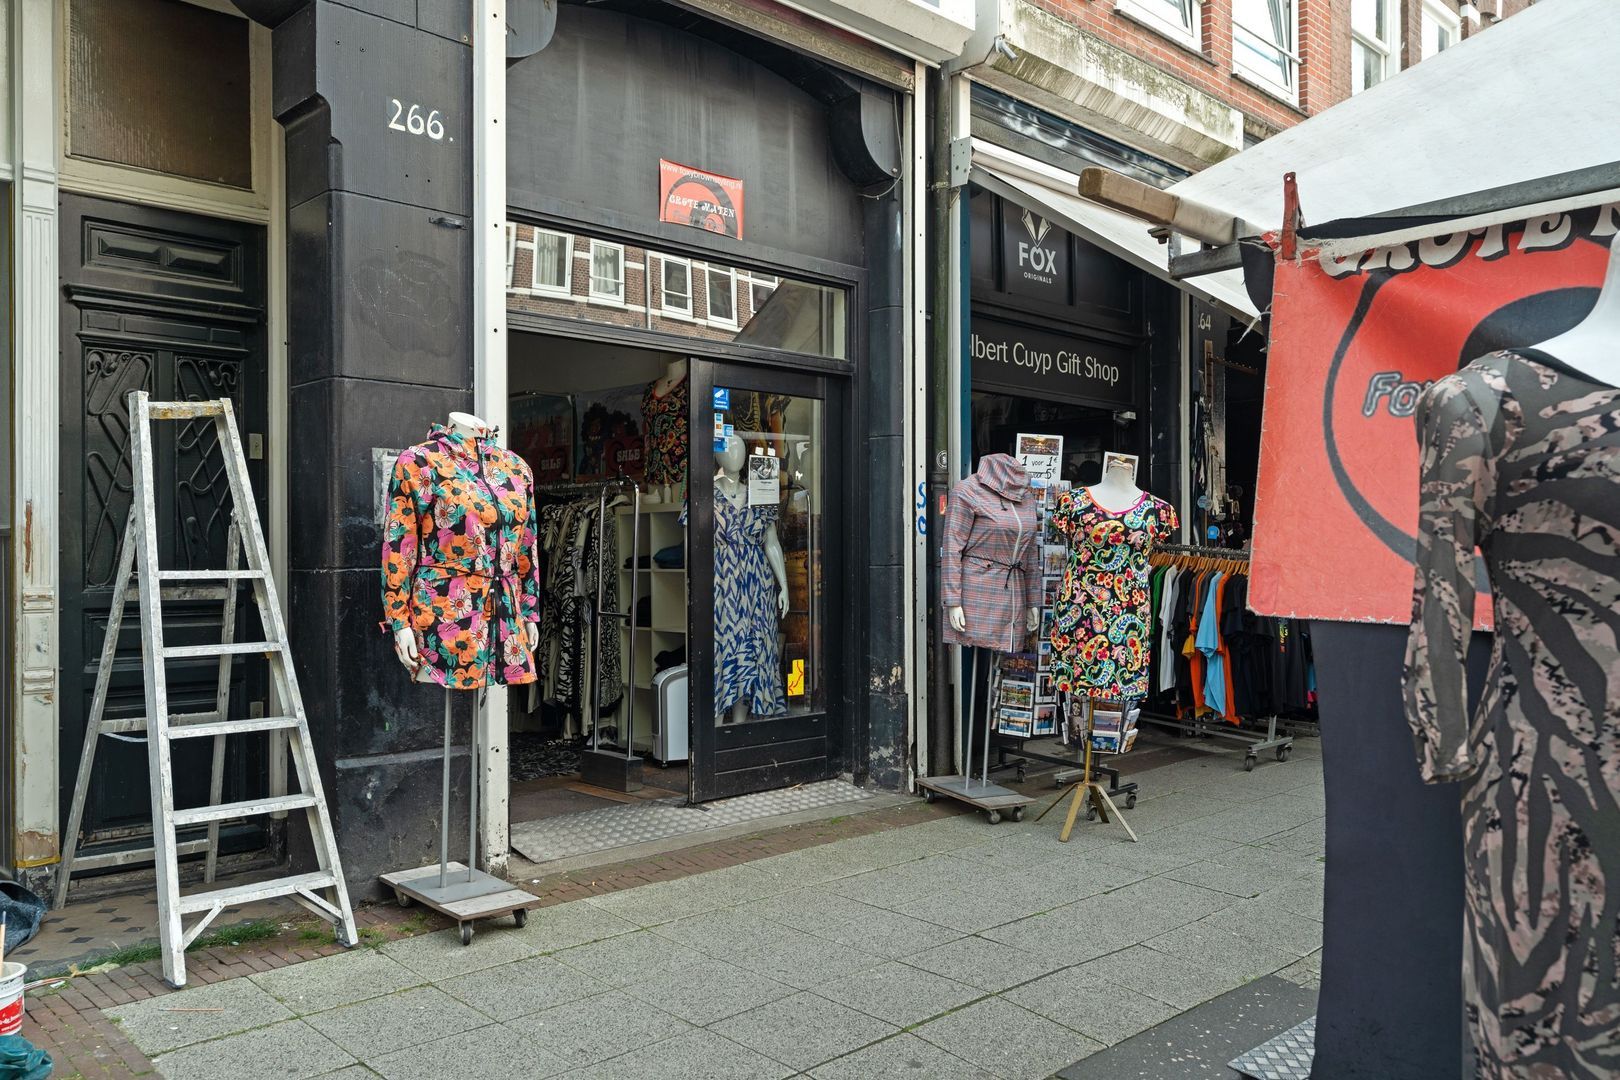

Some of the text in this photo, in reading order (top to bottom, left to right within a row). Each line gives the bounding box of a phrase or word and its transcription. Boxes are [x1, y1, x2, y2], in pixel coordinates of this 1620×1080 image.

[668, 194, 699, 209] GROTE
[701, 202, 736, 218] MATEN
[1018, 241, 1057, 275] FOX
[1023, 271, 1052, 284] ORIGINALS
[1197, 312, 1211, 331] 64
[970, 333, 1119, 387] lbert Cuyp Gift Shop
[1361, 371, 1436, 418] Fo
[616, 448, 641, 463] SALE
[1021, 455, 1028, 466] 1
